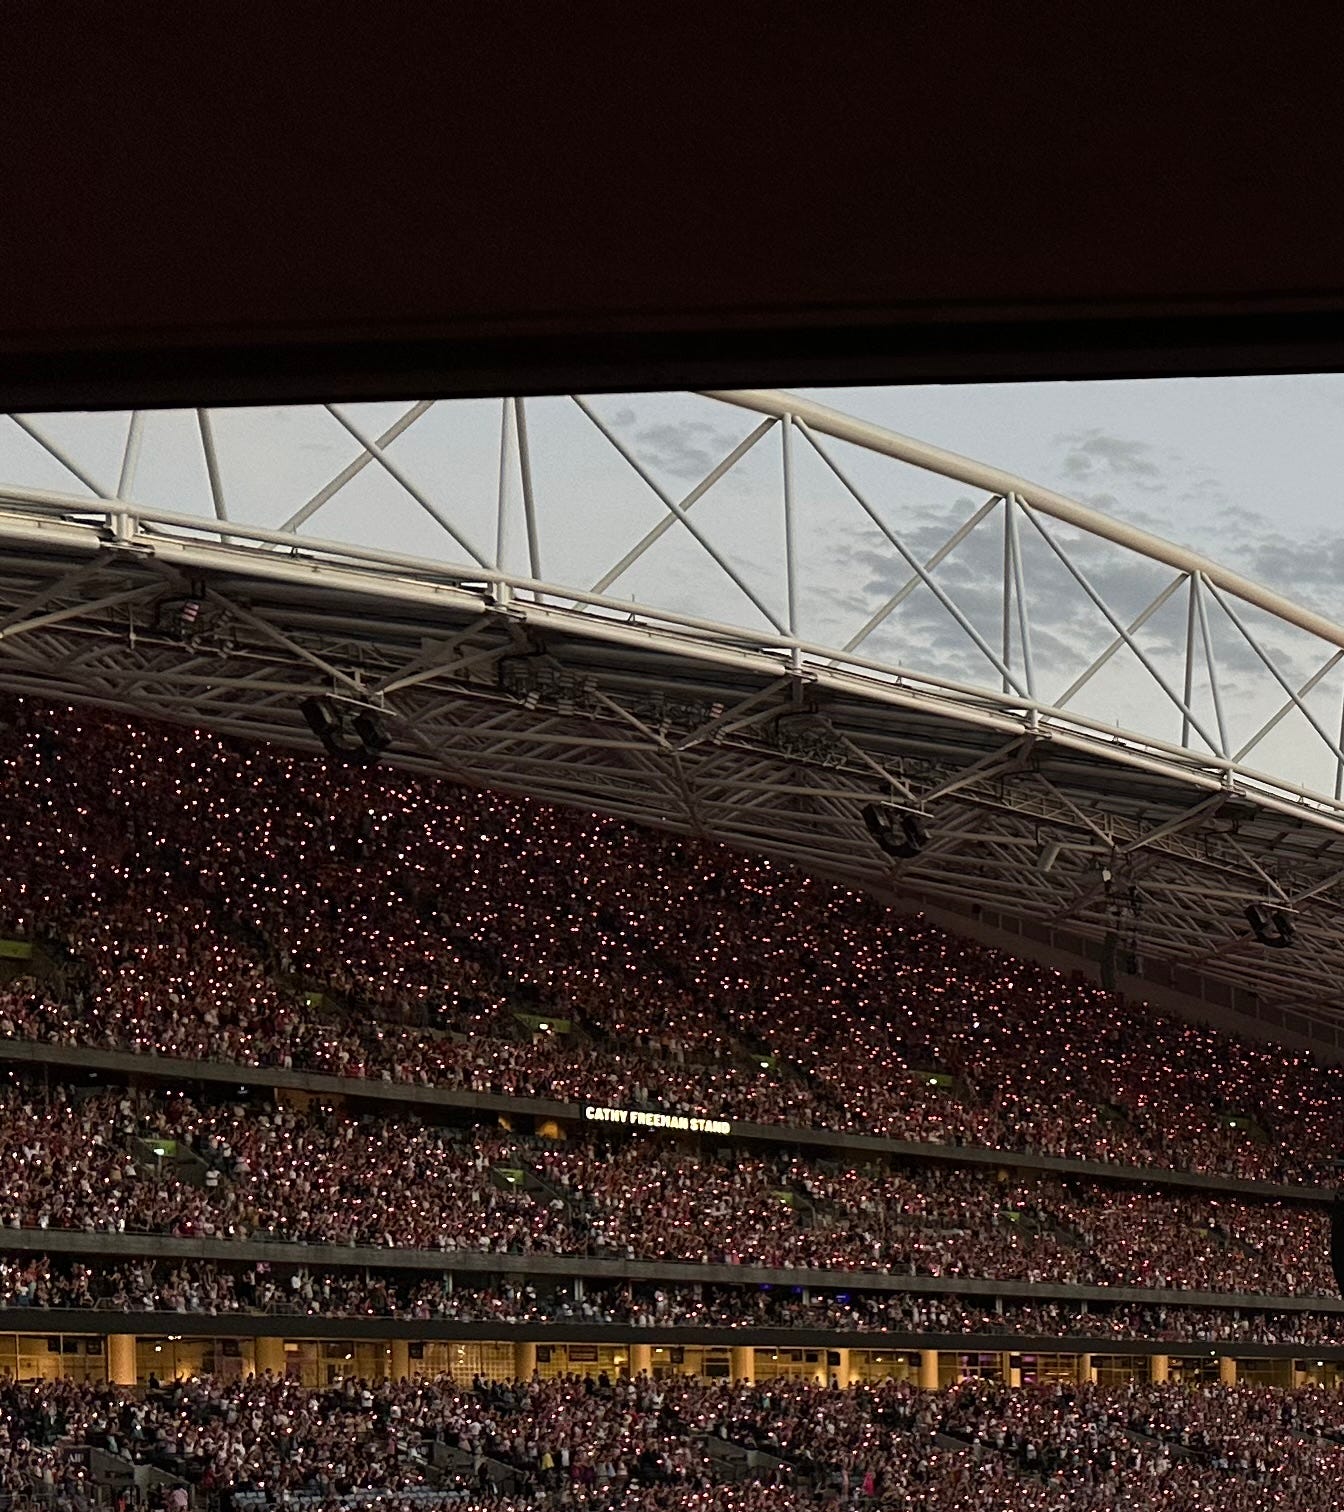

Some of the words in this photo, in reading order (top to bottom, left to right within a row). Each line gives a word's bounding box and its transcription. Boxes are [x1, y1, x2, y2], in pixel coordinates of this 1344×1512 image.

[585, 1106, 628, 1123] CATHY
[630, 1111, 688, 1130] FREEMAN
[690, 1118, 731, 1135] STAND
